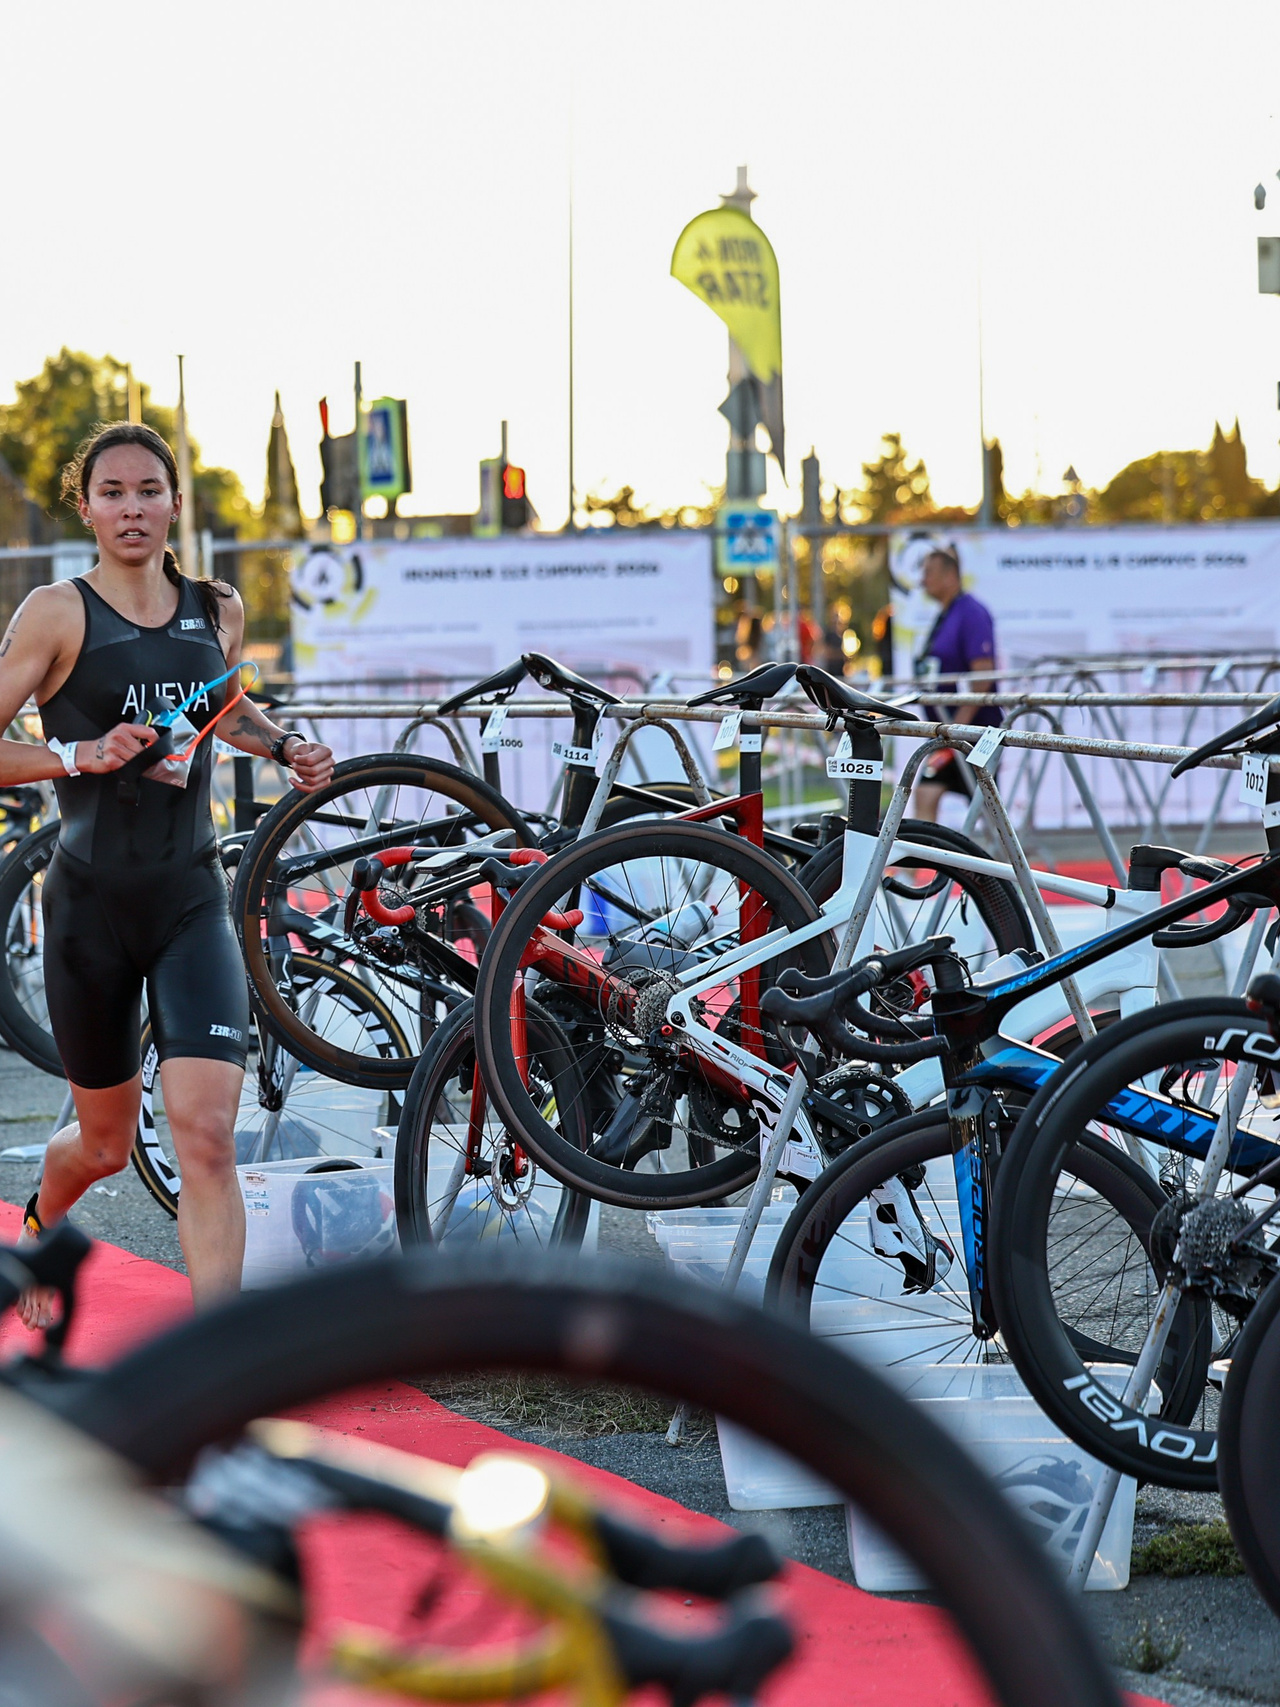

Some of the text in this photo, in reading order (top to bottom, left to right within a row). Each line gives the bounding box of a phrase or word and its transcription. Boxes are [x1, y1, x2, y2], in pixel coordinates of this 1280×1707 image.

[500, 738, 523, 748] 1000
[564, 749, 589, 762] 1114
[840, 763, 874, 775] 1025
[1245, 771, 1264, 793] 1012
